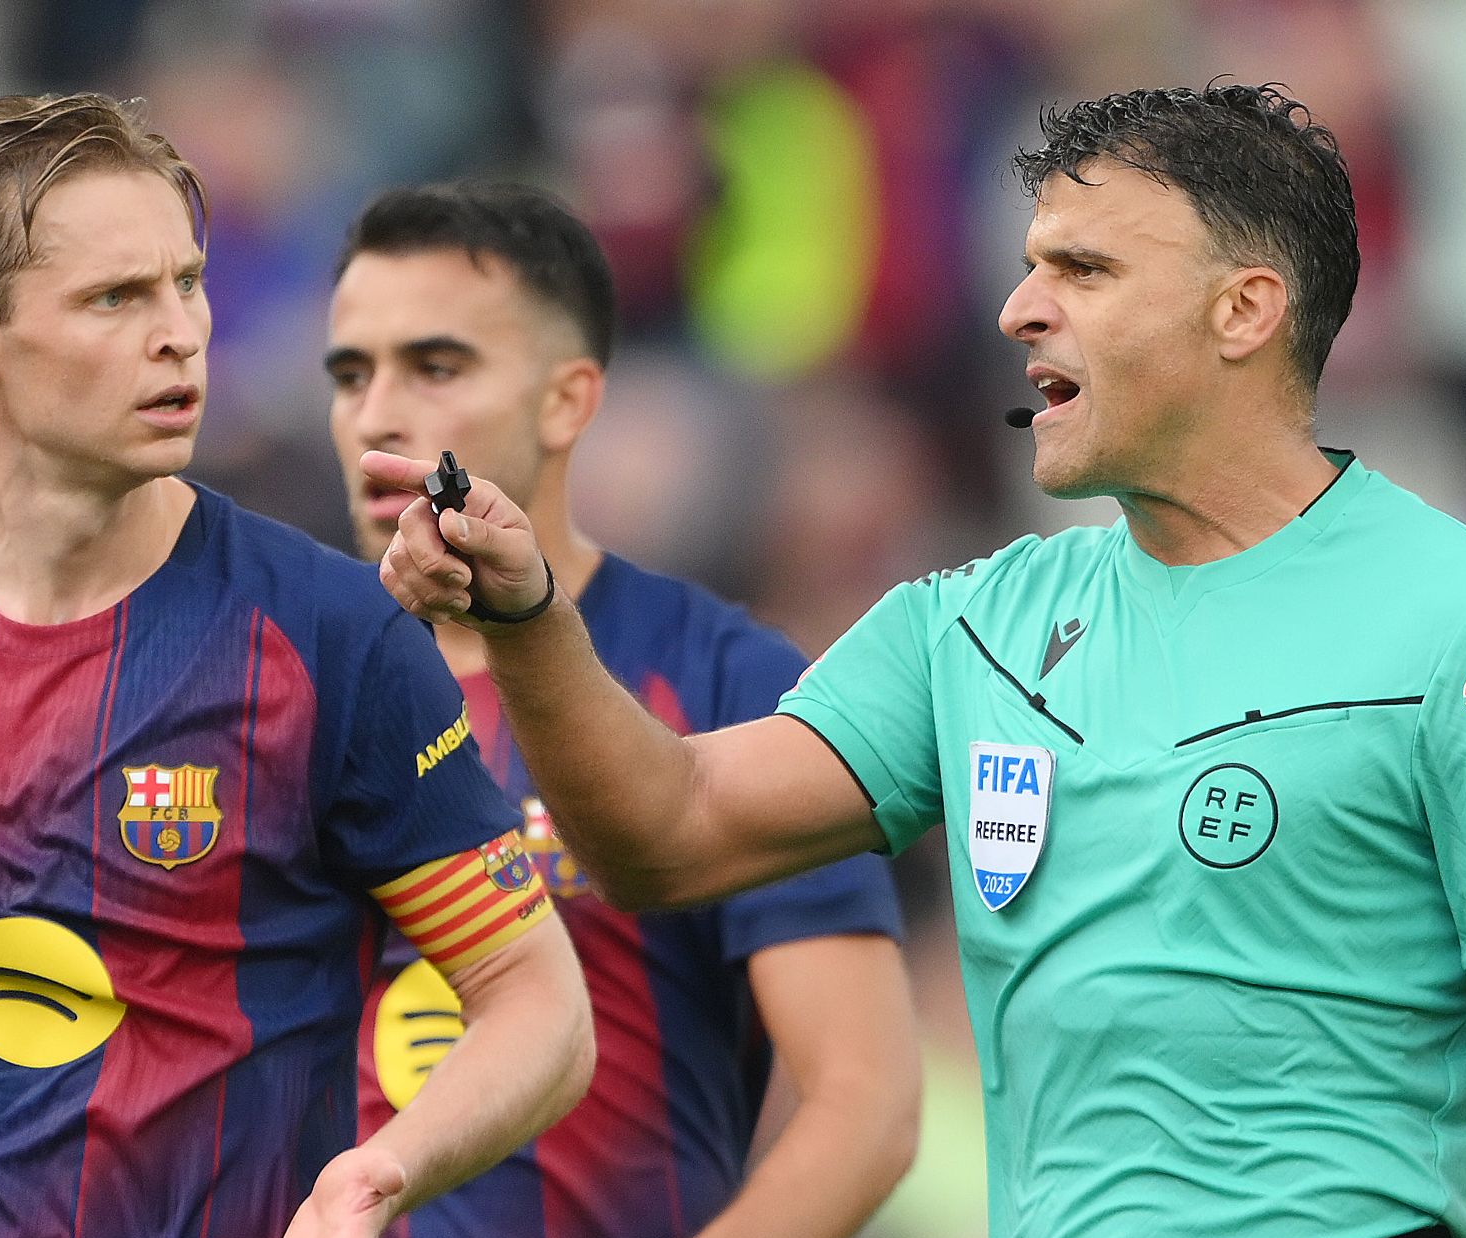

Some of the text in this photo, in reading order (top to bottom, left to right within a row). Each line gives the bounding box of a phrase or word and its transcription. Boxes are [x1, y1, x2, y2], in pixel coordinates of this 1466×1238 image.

[977, 754, 1040, 796] FIFA
[975, 820, 1037, 843] REFEREE
[983, 874, 1013, 895] 2025
